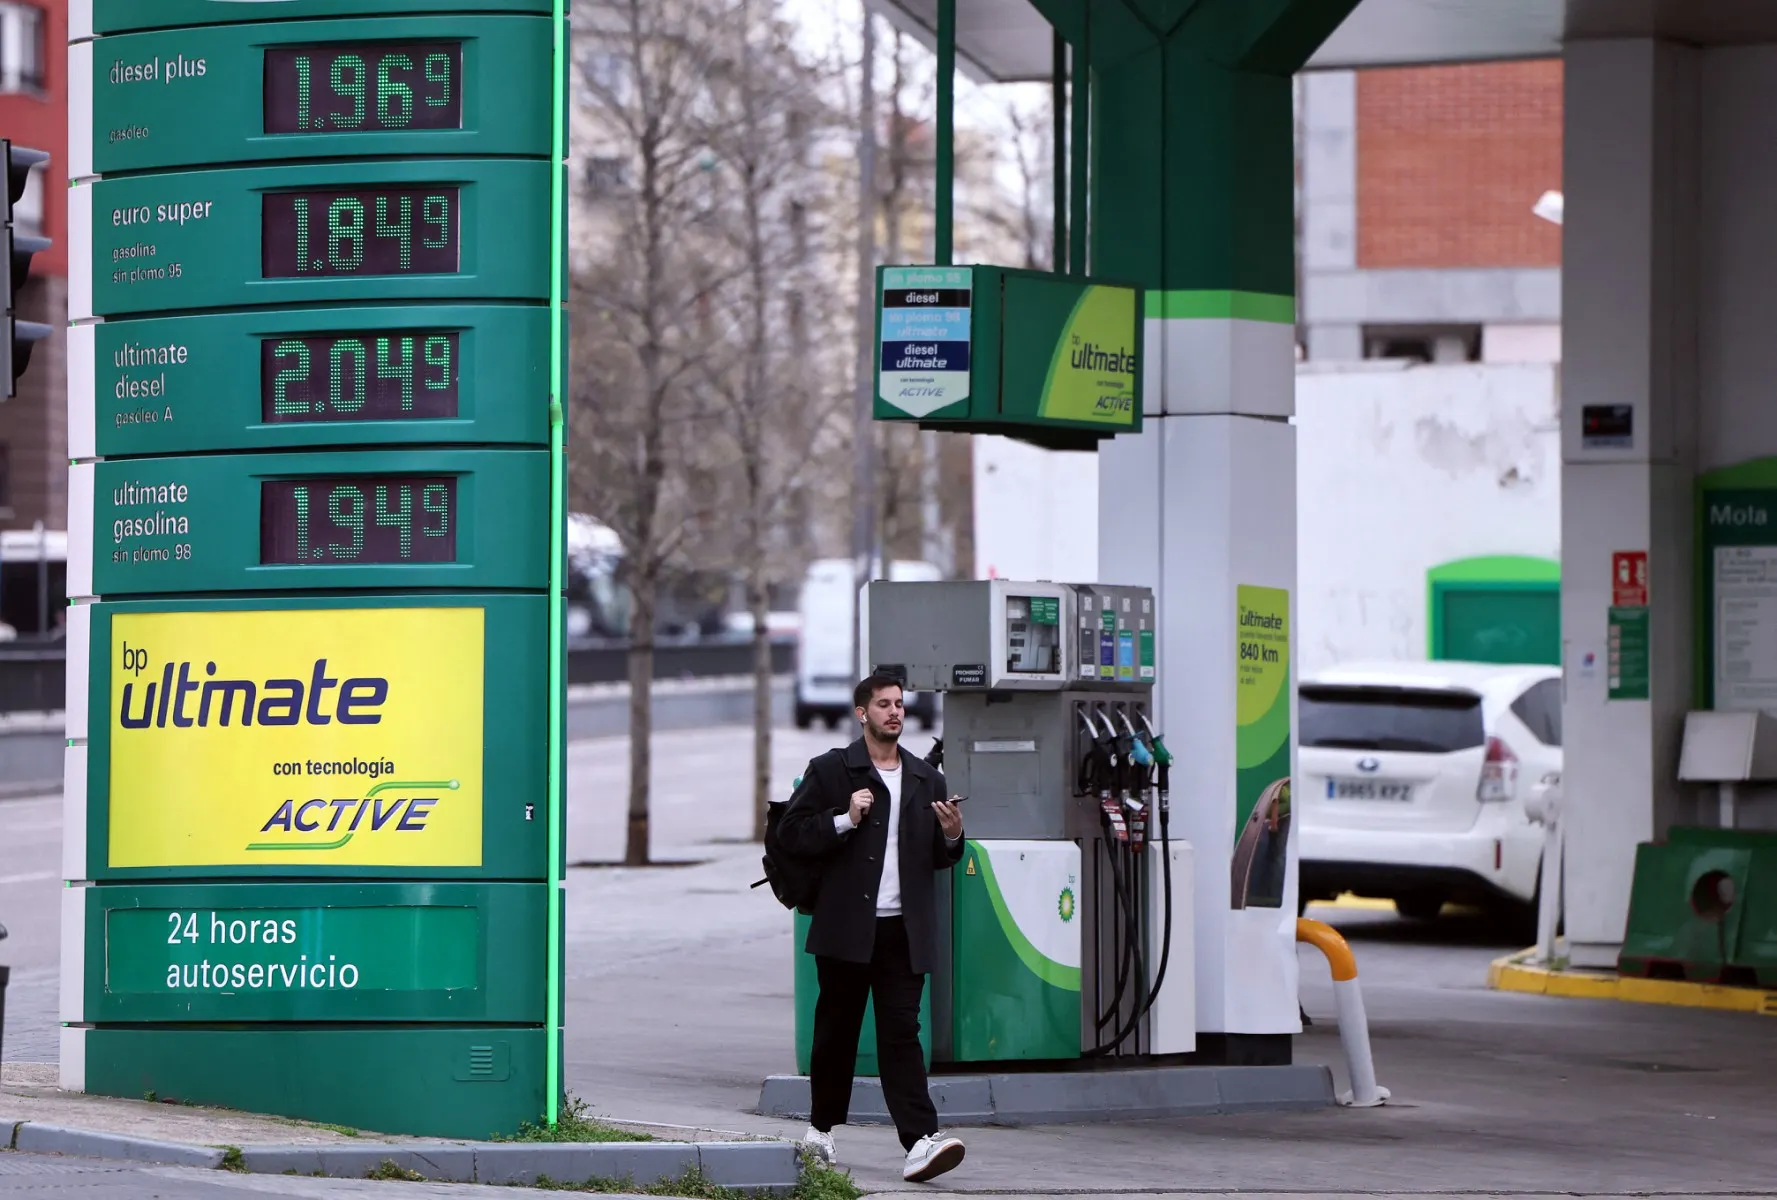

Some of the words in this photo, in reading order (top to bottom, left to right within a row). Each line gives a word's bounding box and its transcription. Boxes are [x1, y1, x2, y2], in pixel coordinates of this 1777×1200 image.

[110, 56, 159, 85] diesel
[165, 53, 207, 84] plus
[295, 52, 451, 129] 1.969
[109, 124, 149, 144] gasóleo
[112, 204, 150, 227] euro
[156, 199, 213, 227] super
[293, 195, 449, 272] 1.849
[112, 242, 156, 262] gasolina
[112, 267, 128, 284] sin
[130, 264, 165, 284] plomo
[168, 263, 182, 278] 95
[905, 291, 939, 303] diesel
[114, 341, 188, 368] ultimate
[904, 343, 938, 355] diesel
[1071, 343, 1135, 374] ultimate
[273, 335, 451, 415] 2.049
[896, 356, 948, 369] ultimate
[115, 373, 165, 399] diesel
[898, 387, 946, 397] ACTIVE
[115, 407, 159, 428] gasóleo
[163, 405, 174, 422] A
[1095, 396, 1132, 411] ACTIVE
[113, 480, 188, 506] ultimate
[113, 511, 189, 543] gasolina
[293, 483, 449, 560] 1.949
[112, 547, 129, 563] sin
[133, 545, 171, 564] plomo
[174, 542, 192, 560] 98
[1240, 610, 1283, 630] ultimate
[122, 640, 148, 677] bp
[1240, 642, 1259, 661] 840
[1262, 644, 1279, 663] km
[120, 658, 389, 729] ultimate
[272, 759, 302, 776] con
[305, 756, 395, 779] tecnología
[260, 797, 441, 833] ACTIVE
[166, 911, 200, 945] 24
[210, 911, 297, 944] horas
[166, 954, 359, 989] autoservicio
